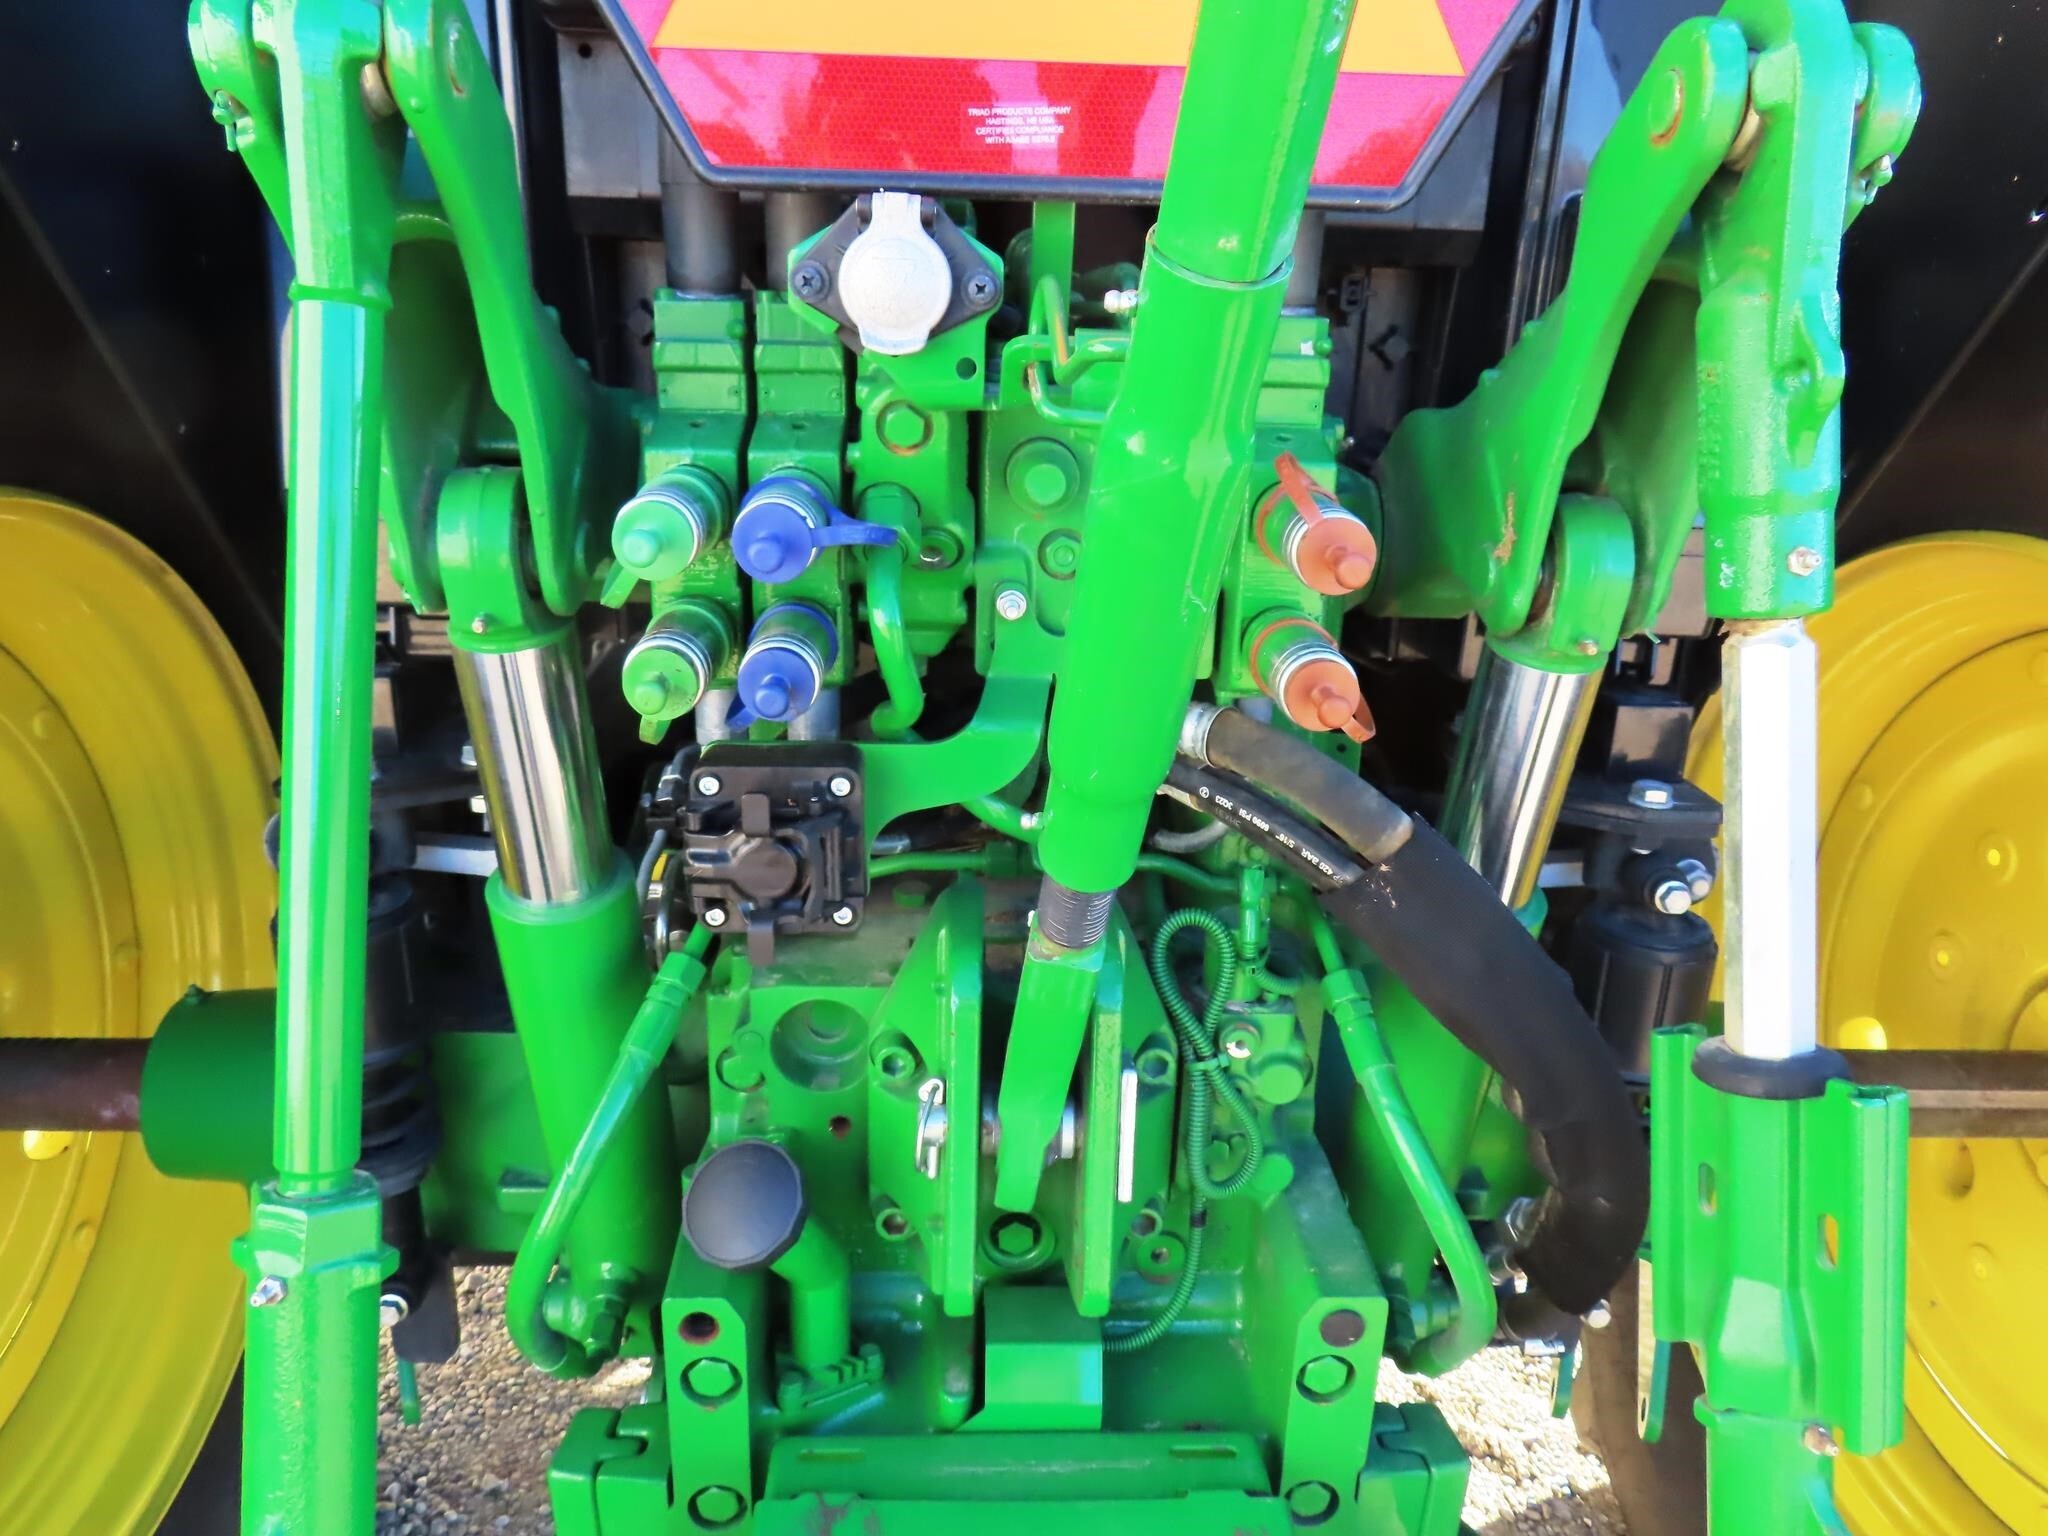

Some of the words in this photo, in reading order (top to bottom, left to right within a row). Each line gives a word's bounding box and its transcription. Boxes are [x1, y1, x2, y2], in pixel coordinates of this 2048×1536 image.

[968, 108, 990, 116] TRIAD
[992, 107, 1033, 115] PRODUCTS
[1034, 106, 1071, 115] COMPANY
[1015, 125, 1064, 134] COMPLIANCE
[1238, 807, 1252, 821] PSI
[1301, 848, 1319, 865] BAR
[1318, 862, 1334, 876] 420
